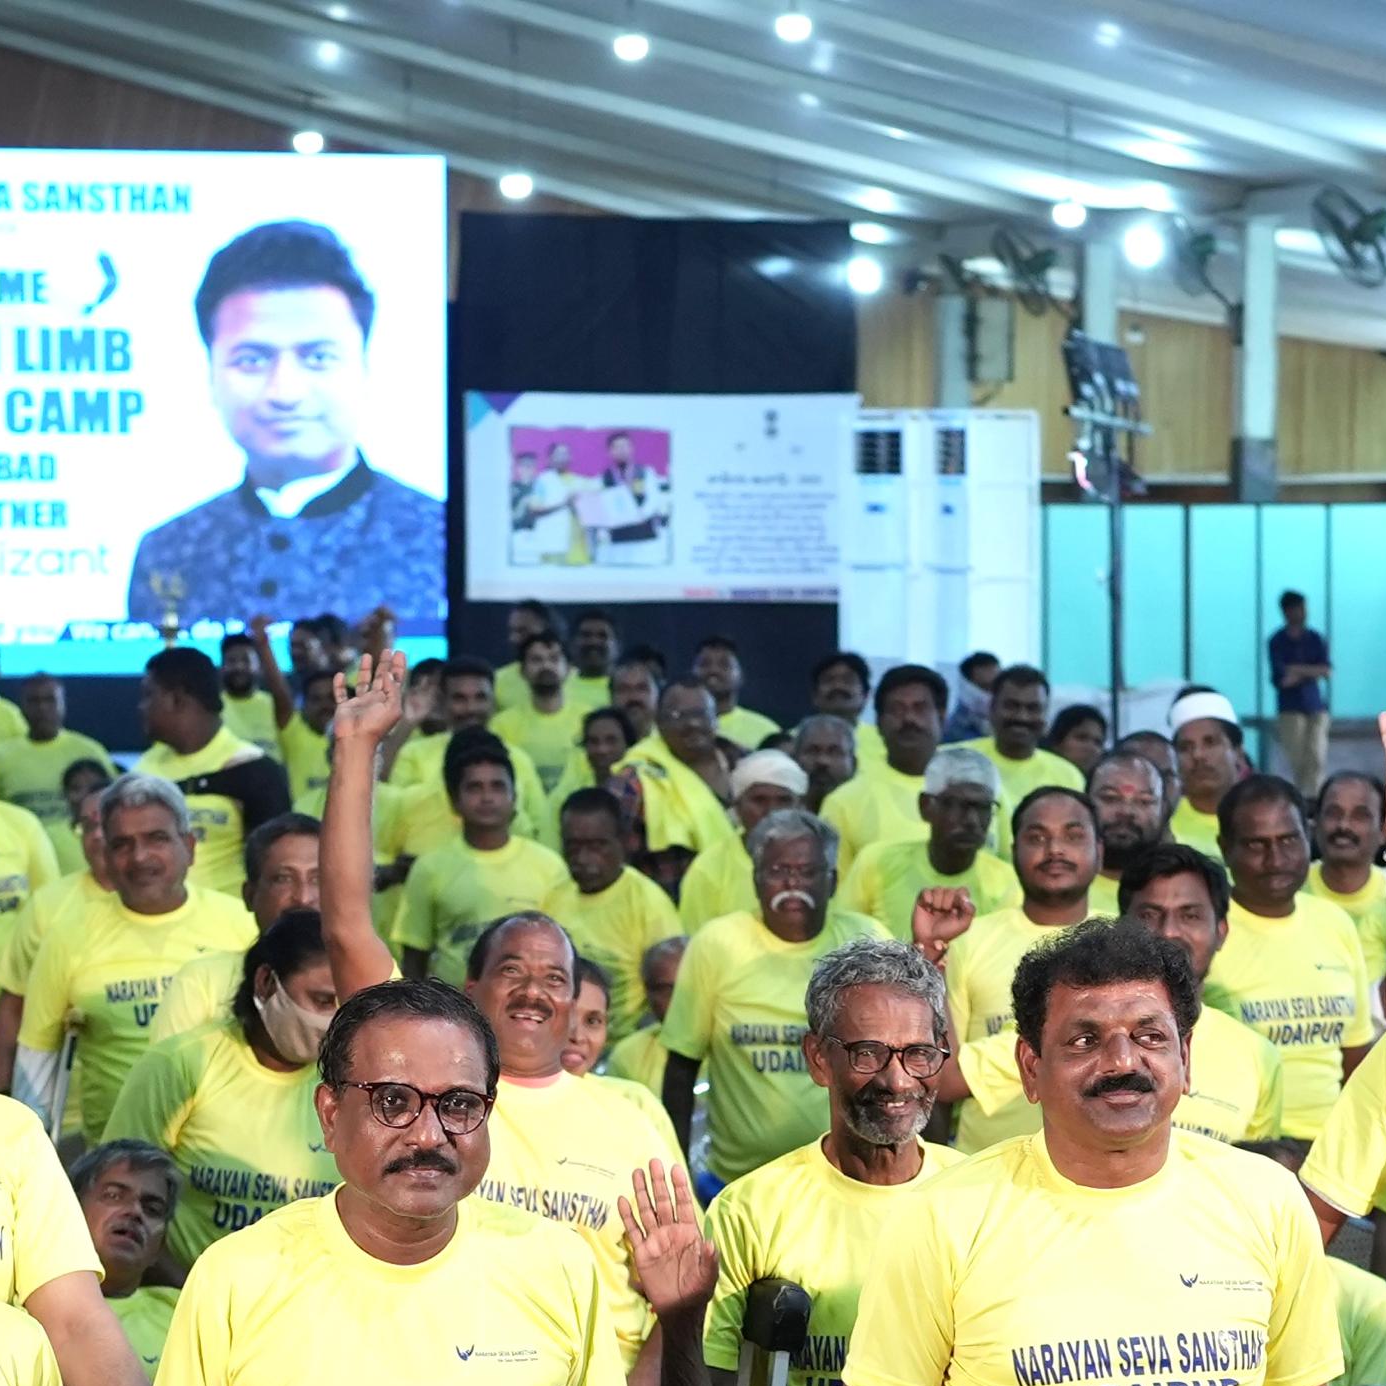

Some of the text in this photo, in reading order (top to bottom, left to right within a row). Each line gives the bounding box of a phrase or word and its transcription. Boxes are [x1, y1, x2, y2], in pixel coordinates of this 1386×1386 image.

[22, 182, 193, 214] SANSTHAN
[13, 327, 133, 374] LIMB
[5, 387, 146, 435] CAMP
[1118, 1333, 1172, 1379] SEVA
